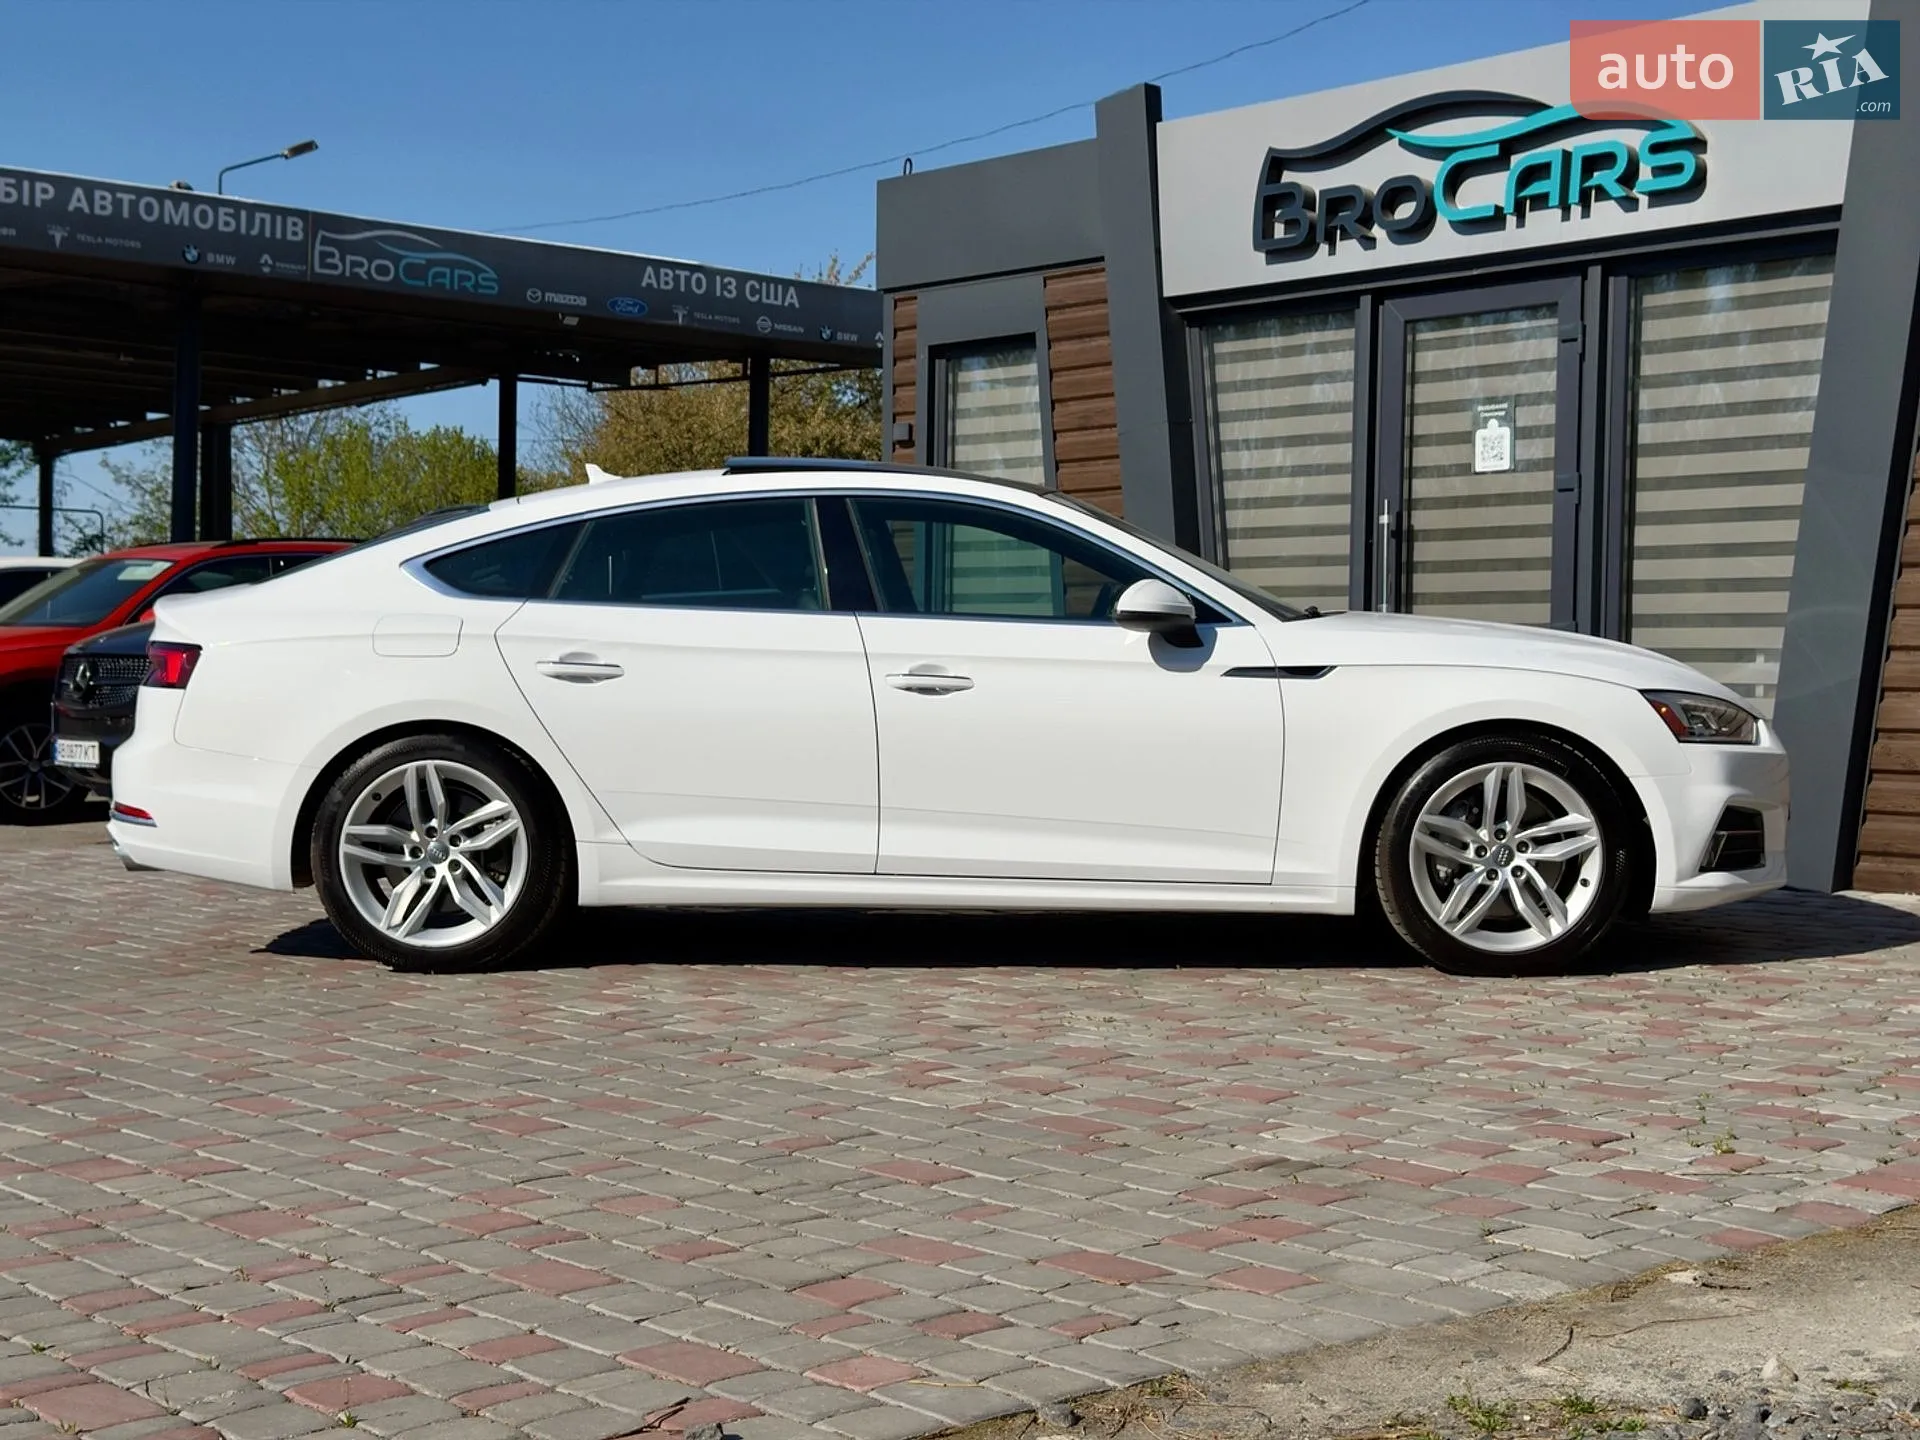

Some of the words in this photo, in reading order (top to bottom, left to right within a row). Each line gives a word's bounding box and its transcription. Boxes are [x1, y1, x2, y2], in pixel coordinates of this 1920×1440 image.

[67, 186, 304, 241] АВТОМОБІЛІВ
[207, 252, 236, 266] BMW
[641, 266, 707, 295] АВТО
[715, 275, 738, 299] ІЗ
[745, 280, 800, 309] США
[774, 322, 804, 334] NISSAN
[836, 331, 858, 342] BMW
